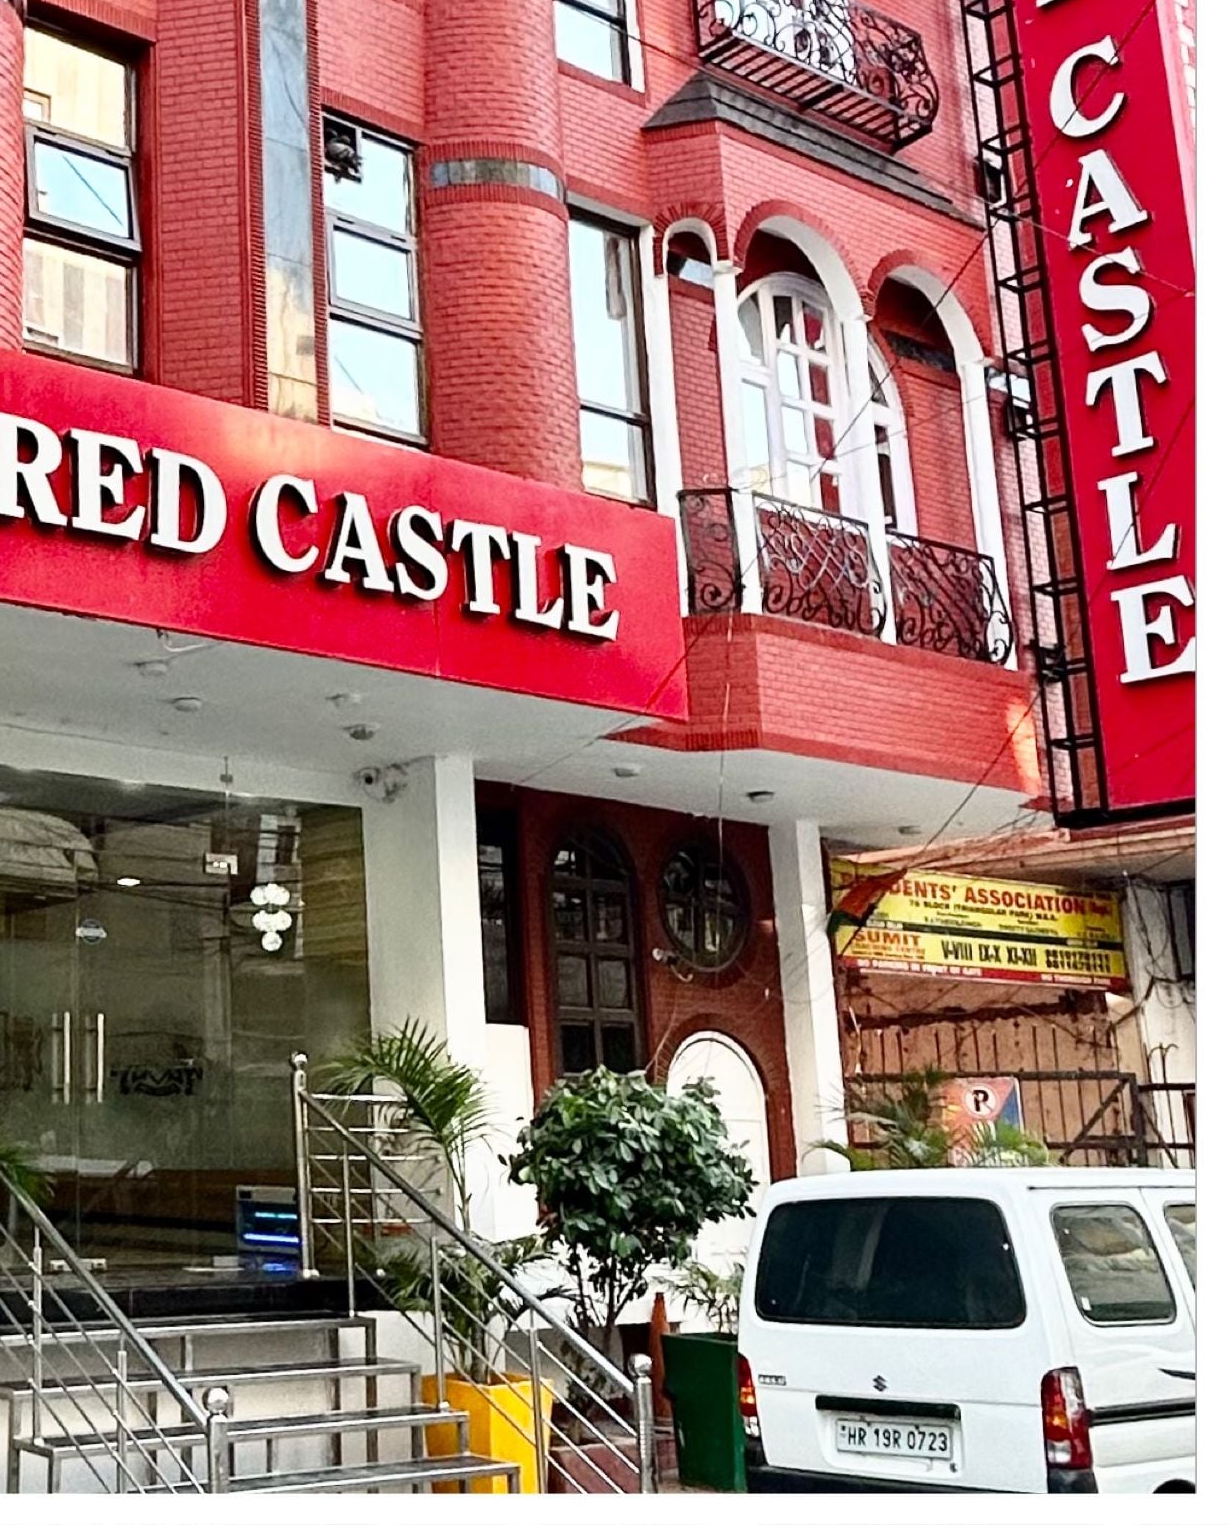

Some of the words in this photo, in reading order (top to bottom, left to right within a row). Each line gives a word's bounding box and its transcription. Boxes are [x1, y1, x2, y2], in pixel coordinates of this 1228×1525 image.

[1049, 35, 1196, 684] CASTLE
[253, 475, 619, 642] CASTLE
[965, 886, 1086, 916] ASSOCIATION
[854, 929, 922, 947] SUMIT
[847, 1426, 867, 1446] HR
[873, 1428, 902, 1449] 19R
[906, 1431, 948, 1452] 0723
